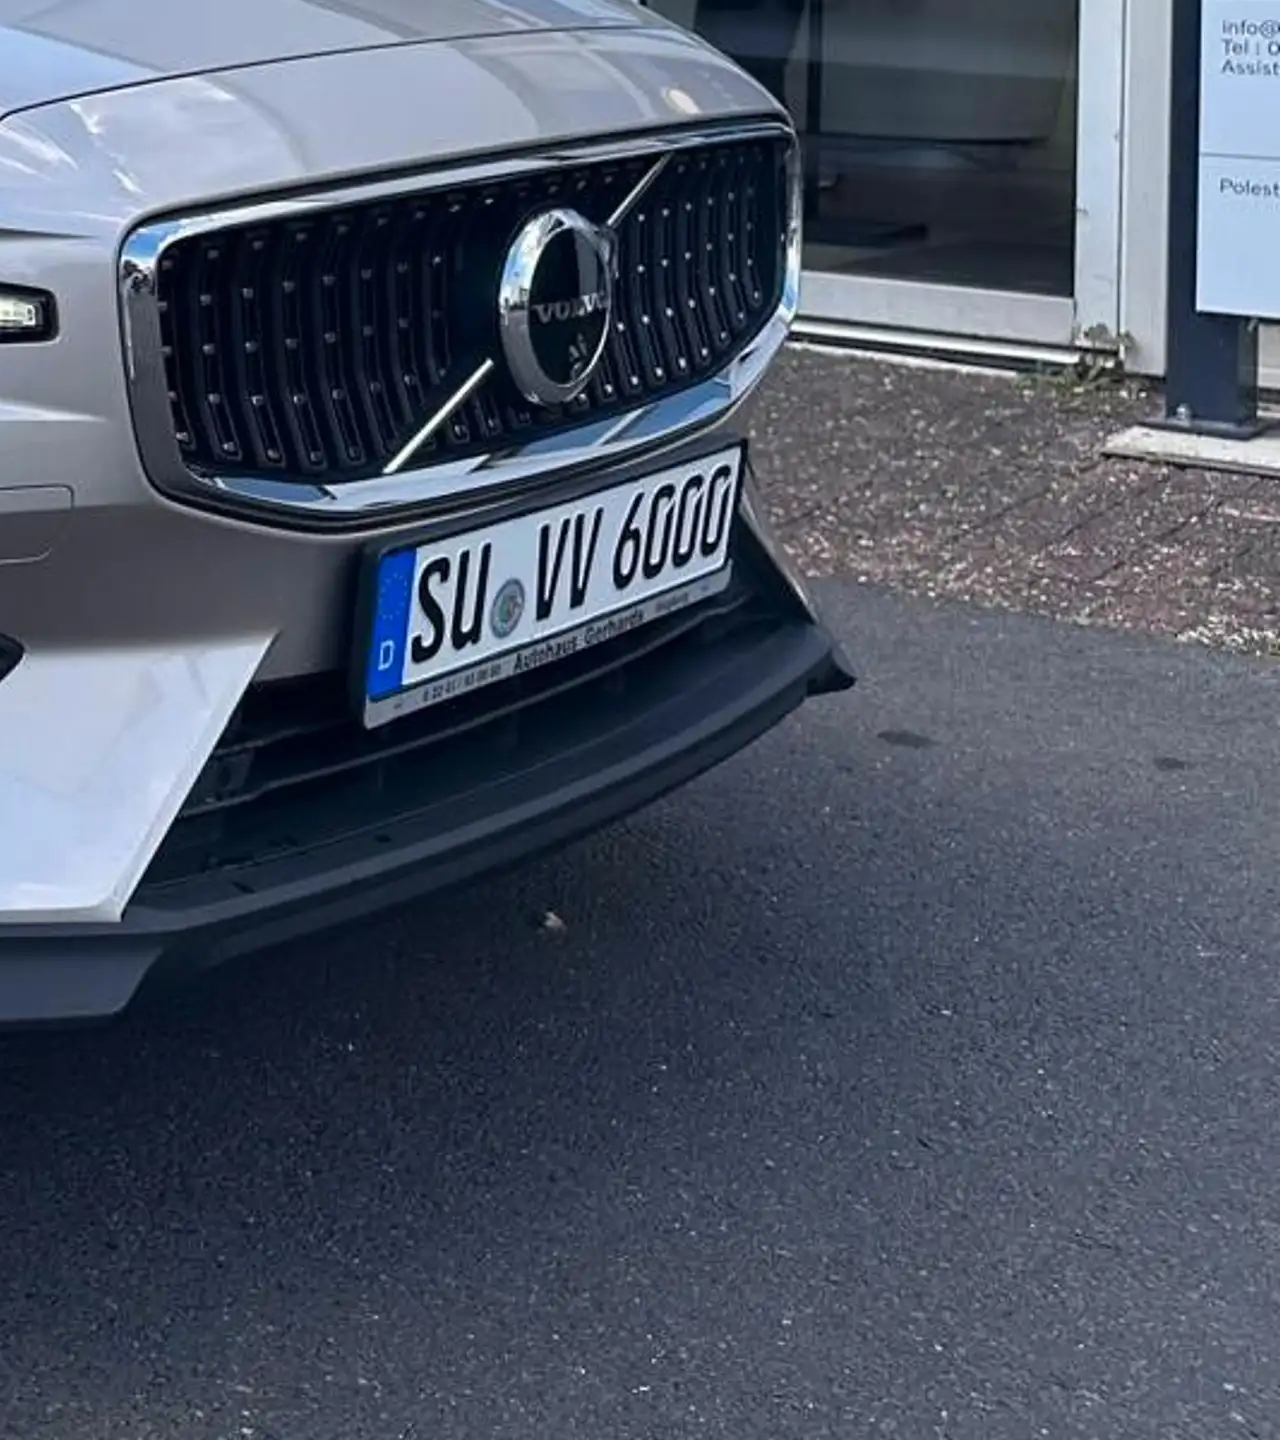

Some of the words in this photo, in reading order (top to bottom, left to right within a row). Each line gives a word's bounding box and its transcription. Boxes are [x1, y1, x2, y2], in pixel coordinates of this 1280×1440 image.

[377, 639, 396, 672] D
[410, 541, 492, 664] SU
[535, 505, 604, 622] VV
[612, 464, 732, 591] 6000
